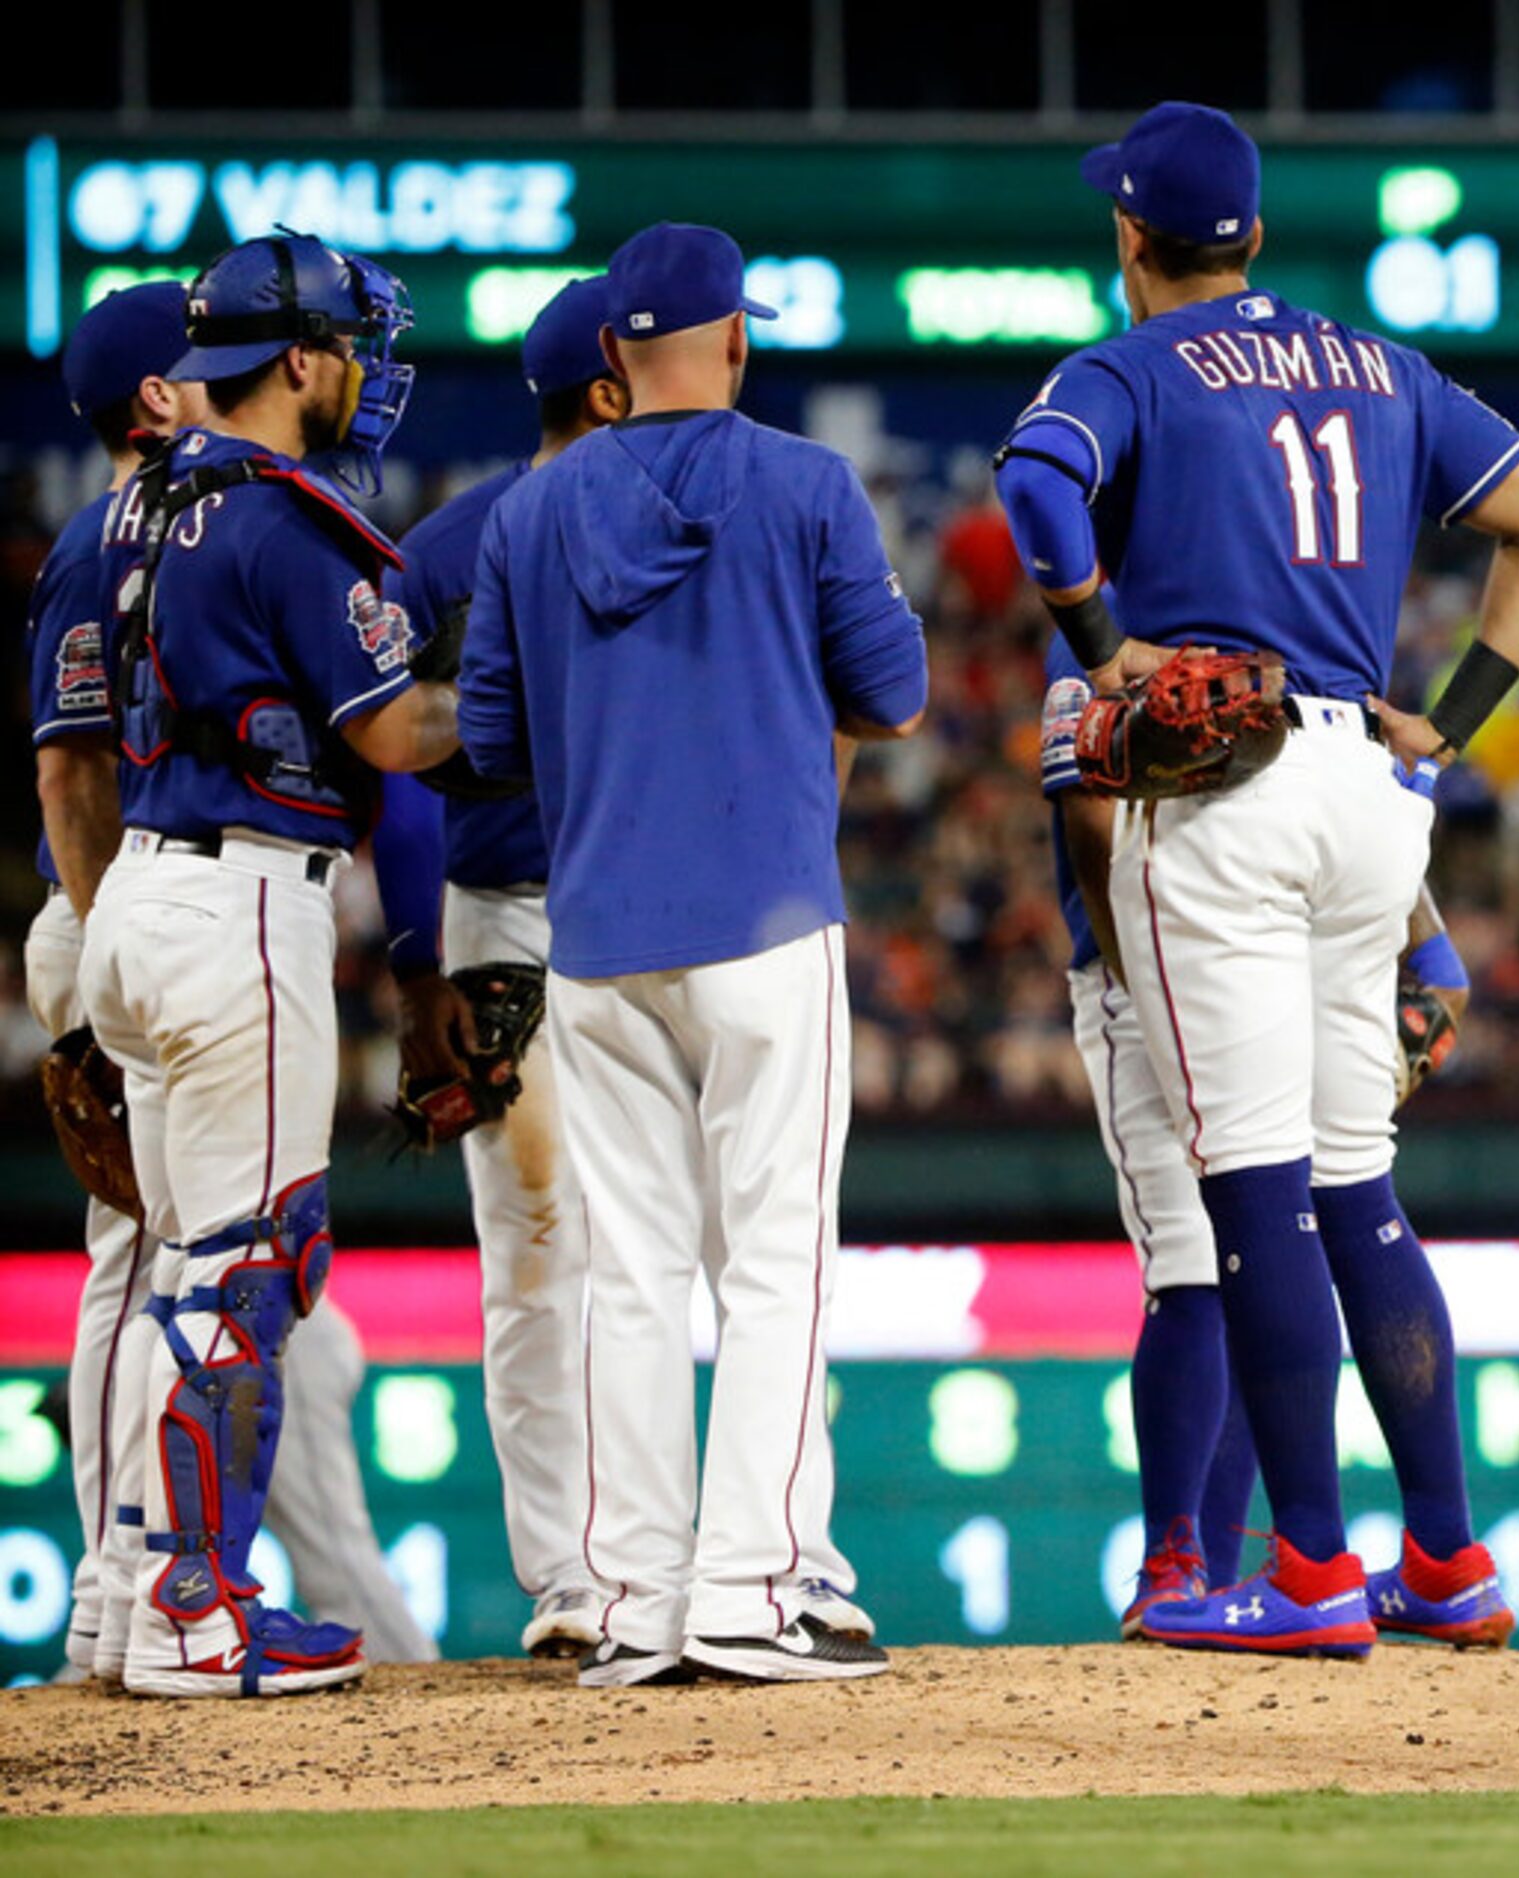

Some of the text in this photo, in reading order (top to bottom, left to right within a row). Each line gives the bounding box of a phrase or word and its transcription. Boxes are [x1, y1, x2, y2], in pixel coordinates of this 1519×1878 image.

[213, 159, 578, 252] VALDEZ
[897, 267, 1109, 343] TOTAL
[1174, 320, 1395, 397] GUZMÁN
[1268, 408, 1365, 568] 11
[928, 1367, 1019, 1477] 8
[938, 1513, 1011, 1636] 1
